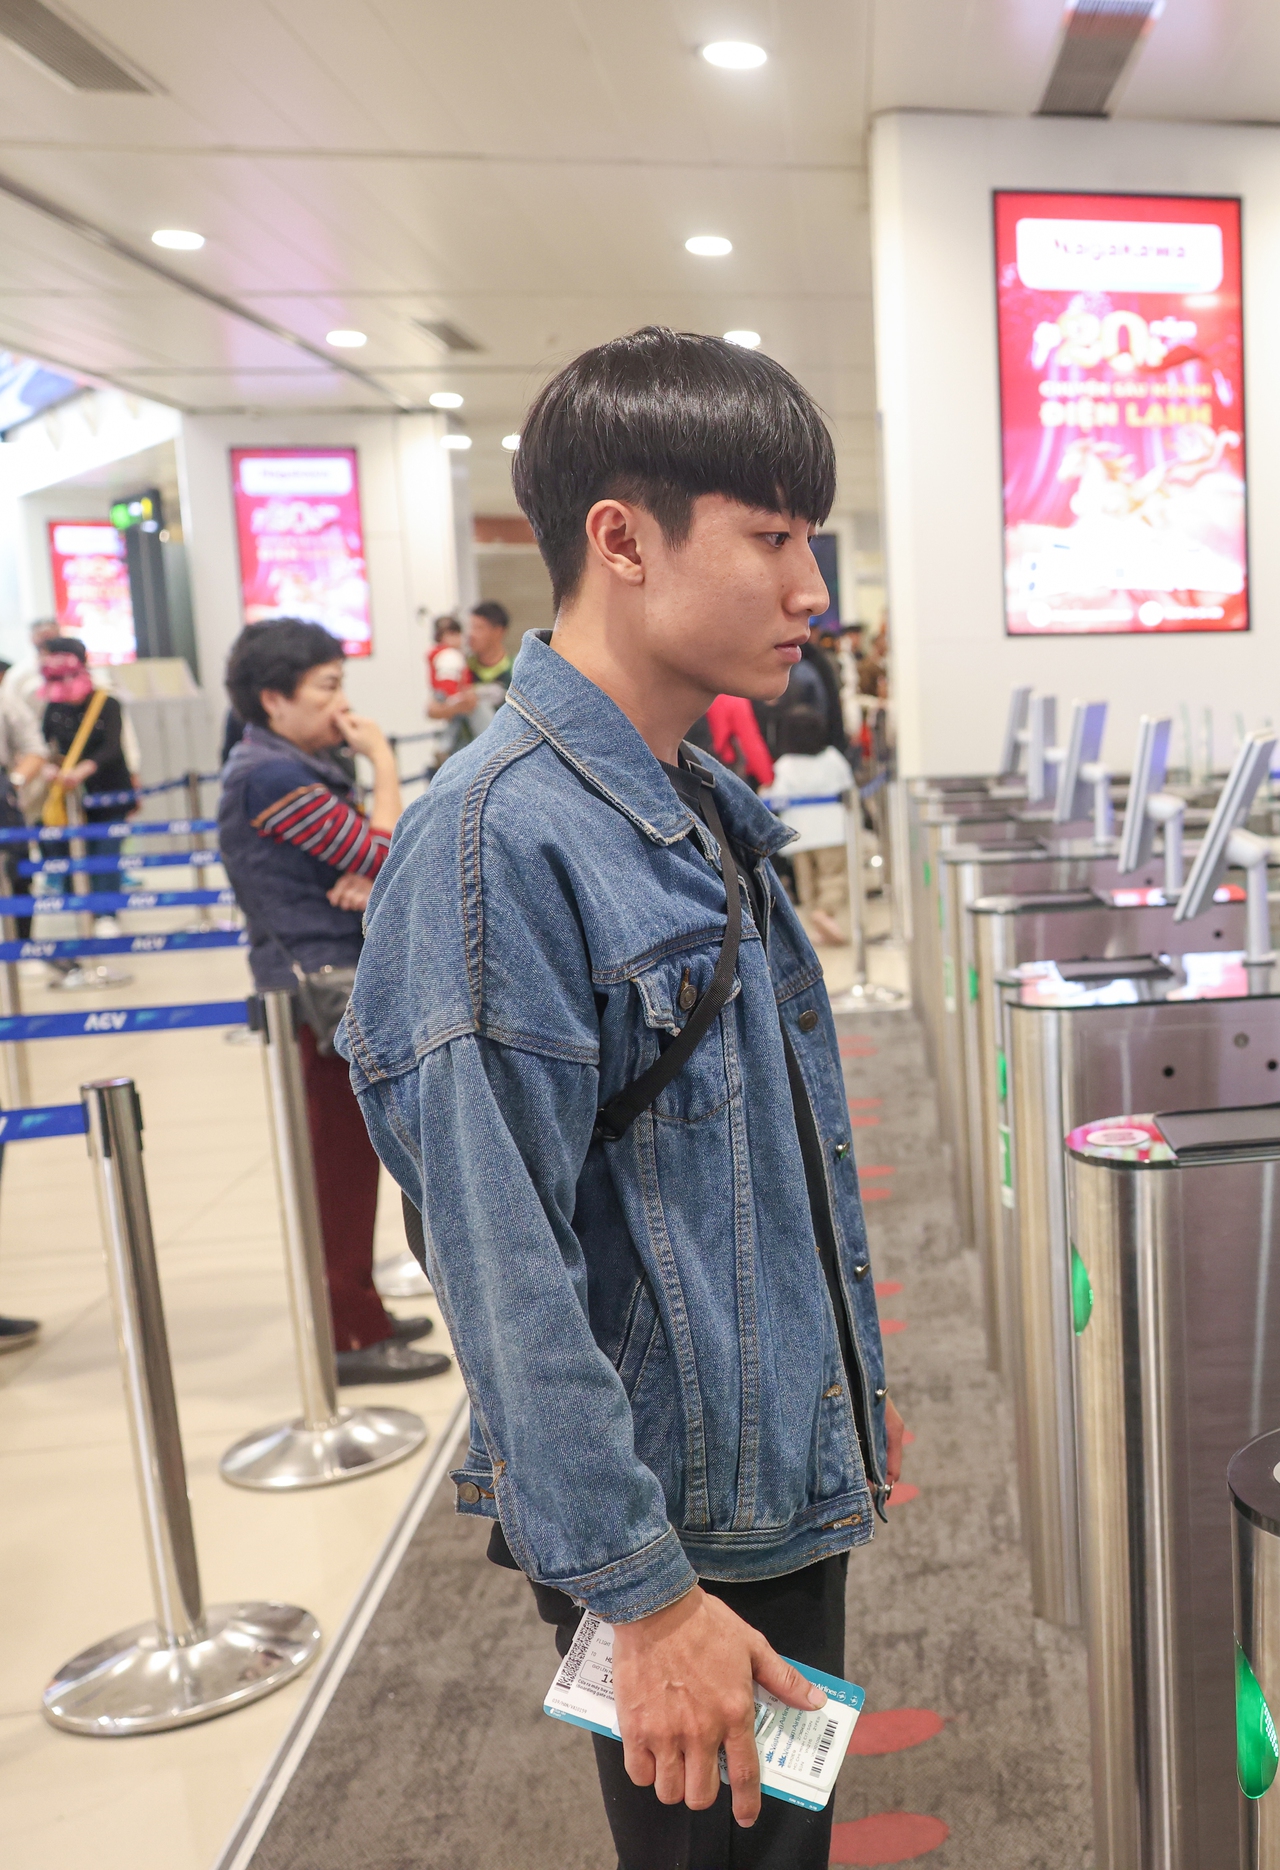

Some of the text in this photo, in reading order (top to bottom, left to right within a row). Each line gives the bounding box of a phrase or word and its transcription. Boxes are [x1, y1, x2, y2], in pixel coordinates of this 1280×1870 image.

[83, 1011, 128, 1031] ACV
[779, 1705, 790, 1725] Airline
[792, 1709, 803, 1730] Airline
